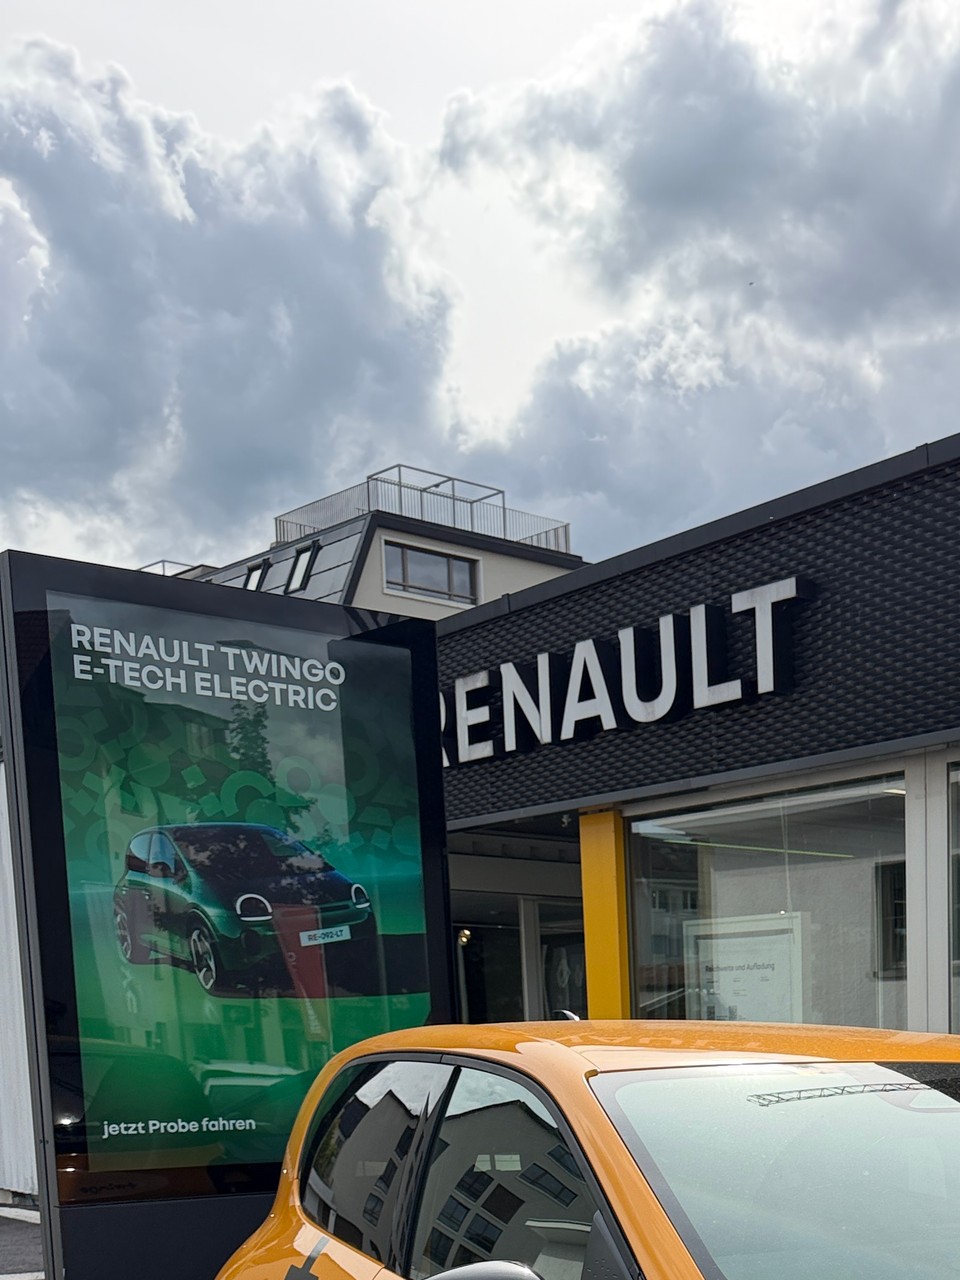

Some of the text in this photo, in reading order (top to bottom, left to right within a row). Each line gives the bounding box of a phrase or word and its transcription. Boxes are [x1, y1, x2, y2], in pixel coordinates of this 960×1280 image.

[70, 623, 346, 686] RENAULT TWINGO
[73, 654, 338, 712] E-TECH ELECTRIC
[438, 577, 797, 768] ENAULT
[102, 1117, 256, 1139] jetzt Probe fahren
